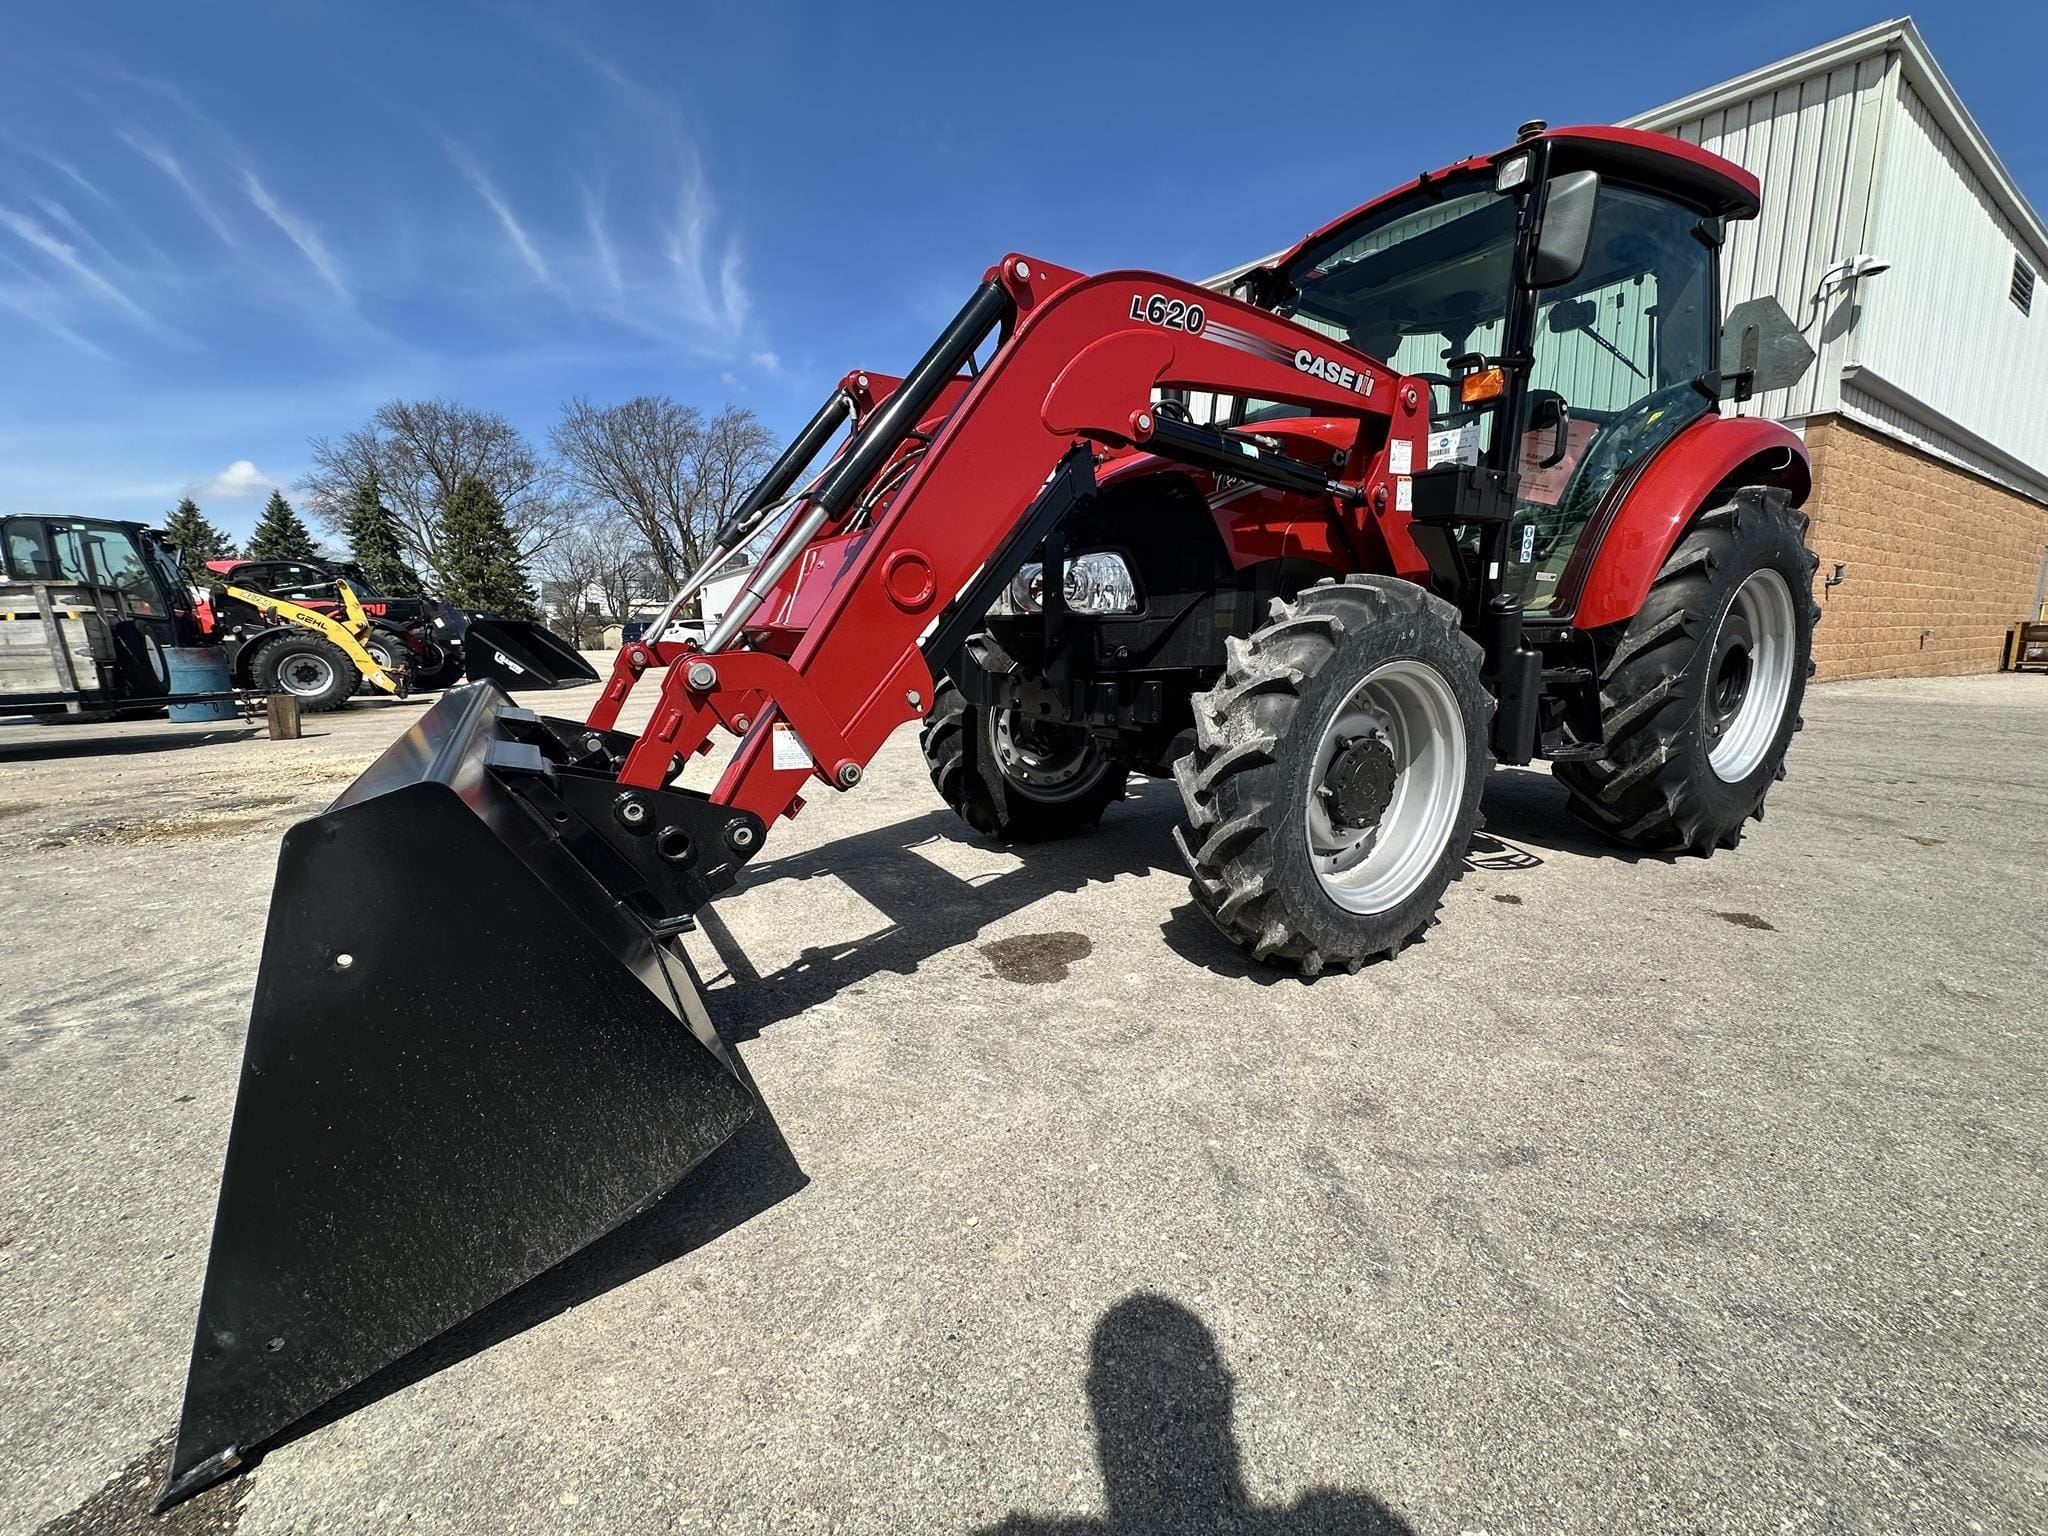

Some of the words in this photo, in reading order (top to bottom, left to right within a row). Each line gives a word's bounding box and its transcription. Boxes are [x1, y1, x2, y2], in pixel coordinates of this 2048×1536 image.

[1130, 294, 1204, 335] L620
[1294, 349, 1356, 390] CASE
[295, 612, 328, 631] GEHL
